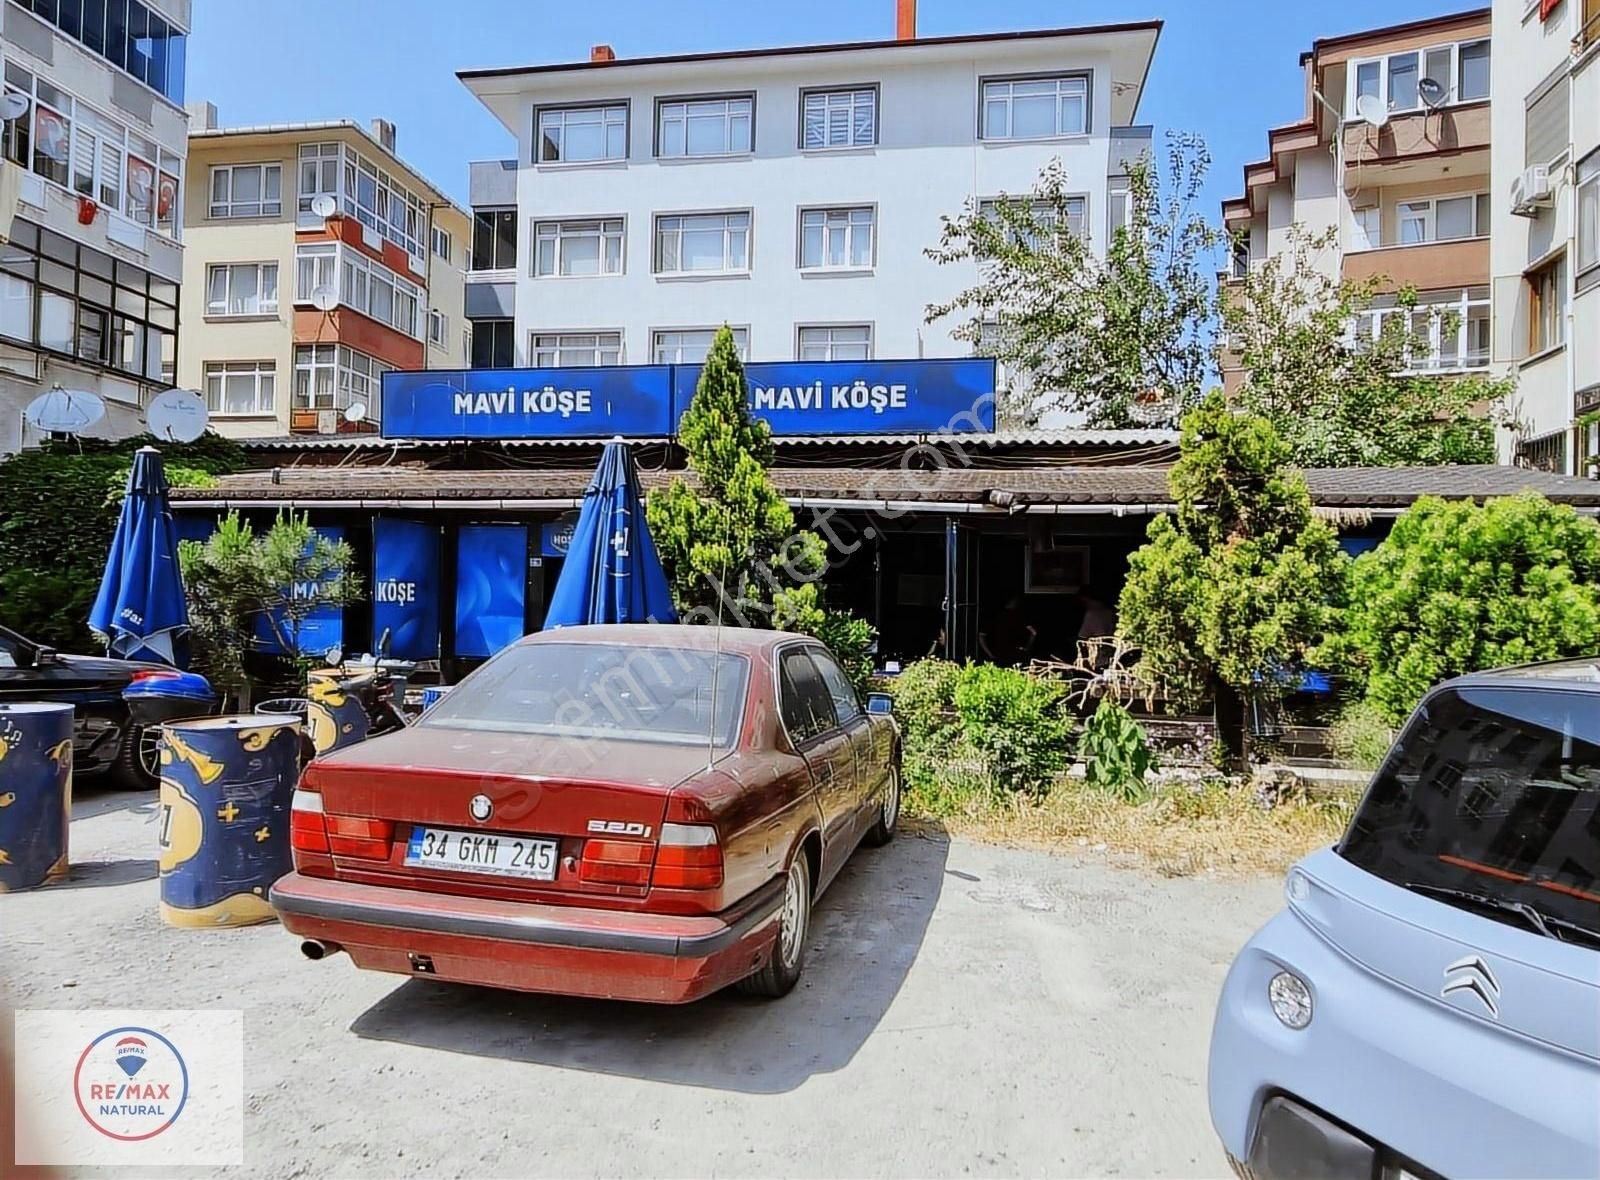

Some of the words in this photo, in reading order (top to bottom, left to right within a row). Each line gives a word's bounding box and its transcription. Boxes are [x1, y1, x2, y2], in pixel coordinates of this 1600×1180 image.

[454, 387, 515, 415] MAVİ
[523, 386, 592, 418] KÖŞE
[754, 381, 822, 410] MAVİ
[831, 380, 907, 414] KÖŞE
[377, 578, 416, 607] KÖŞE
[587, 819, 652, 838] 520i
[422, 832, 449, 858] 34
[458, 836, 499, 864] GKM
[511, 842, 553, 870] 245
